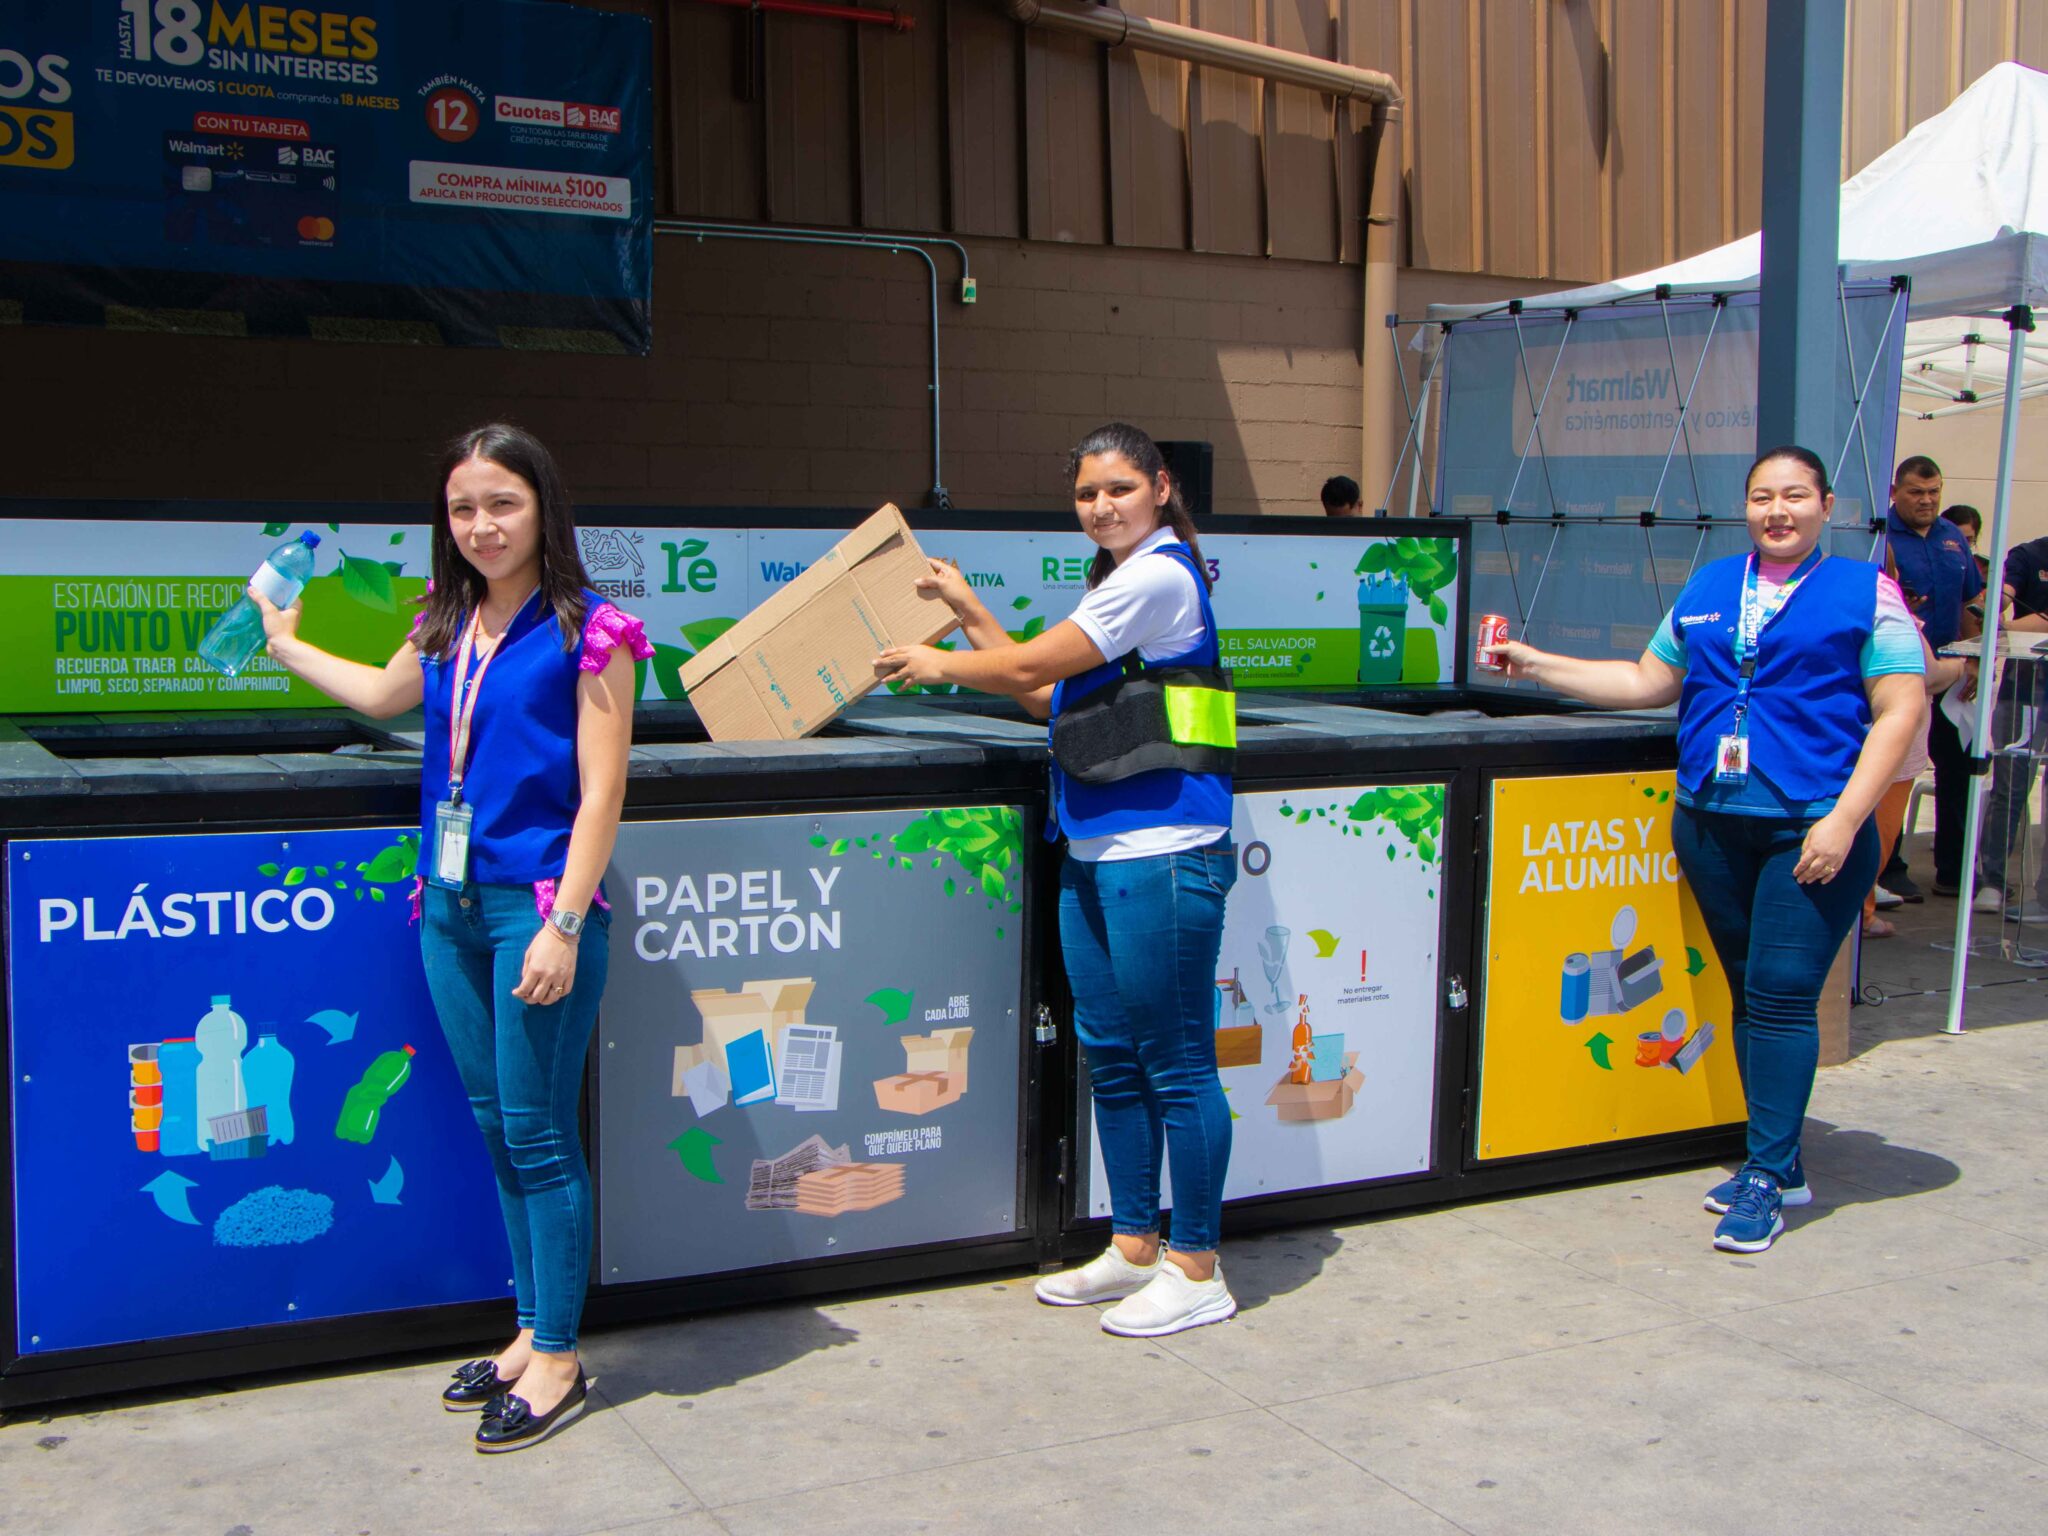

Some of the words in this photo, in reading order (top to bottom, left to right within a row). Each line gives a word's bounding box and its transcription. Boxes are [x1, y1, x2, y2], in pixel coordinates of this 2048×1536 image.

[119, 14, 132, 59] HASTA
[120, 0, 205, 66] 18
[207, 0, 379, 61] MESES
[207, 48, 249, 74] SIN
[254, 53, 379, 85] INTERESES
[95, 68, 112, 82] TE
[116, 71, 216, 94] DEVOLVEMOS
[218, 82, 223, 94] 1
[226, 82, 275, 99] CUOTA
[277, 91, 331, 105] comprando
[333, 96, 339, 105] a
[340, 93, 353, 106] 18
[356, 95, 400, 110] MESES
[418, 73, 457, 97] TAMBIÉN
[459, 78, 486, 104] HASTA
[433, 98, 469, 132] 12
[498, 101, 561, 122] Cuotas
[589, 108, 618, 126] BAC
[197, 116, 229, 130] CON
[232, 119, 249, 132] TU
[252, 121, 308, 137] TARJETA
[510, 125, 527, 135] CON
[529, 127, 552, 137] TODAS
[553, 130, 567, 139] LAS
[168, 139, 225, 157] Walmart
[510, 134, 543, 146] CRÉDITO
[544, 139, 560, 147] BAC
[302, 147, 335, 165] BAC
[437, 172, 503, 190] COMPRA
[506, 176, 562, 195] MÍNIMA
[565, 175, 607, 199] $100
[419, 188, 457, 199] APLICA
[459, 190, 473, 201] EN
[476, 191, 540, 207] PRODUCTOS
[542, 196, 623, 213] SELECCIONADOS
[760, 561, 810, 582] Wal
[53, 579, 150, 609] ESTACIÓN
[156, 583, 180, 609] DE
[593, 579, 645, 598] estlé
[55, 611, 170, 653] PUNTO
[1746, 602, 1758, 647] REMESAS
[1228, 638, 1243, 650] EL
[1247, 637, 1316, 650] SALVADOR
[56, 657, 128, 674] RECUERDA
[133, 657, 176, 674] TRAER
[1219, 655, 1293, 668] RECICLAJE
[207, 677, 214, 692] Y
[216, 676, 291, 692] COMPRIMIDO
[1522, 818, 1625, 857] LATAS
[1633, 816, 1656, 849] Y
[635, 870, 798, 916] PAPEL
[809, 866, 842, 906] Y
[39, 882, 335, 943] PLÁSTICO
[634, 902, 842, 962] CARTÓN
[1337, 994, 1372, 1005] materiales
[1372, 993, 1390, 1002] rotos
[1354, 984, 1383, 994] entregar
[948, 994, 970, 1009] ABRE
[924, 1008, 946, 1022] CADA
[948, 1006, 970, 1020] LADO
[864, 1128, 918, 1146] COMPRÍMELO
[920, 1126, 942, 1140] PARA
[868, 1143, 885, 1157] QUE
[886, 1140, 914, 1154] QUEDE
[914, 1136, 942, 1151] PLANO
